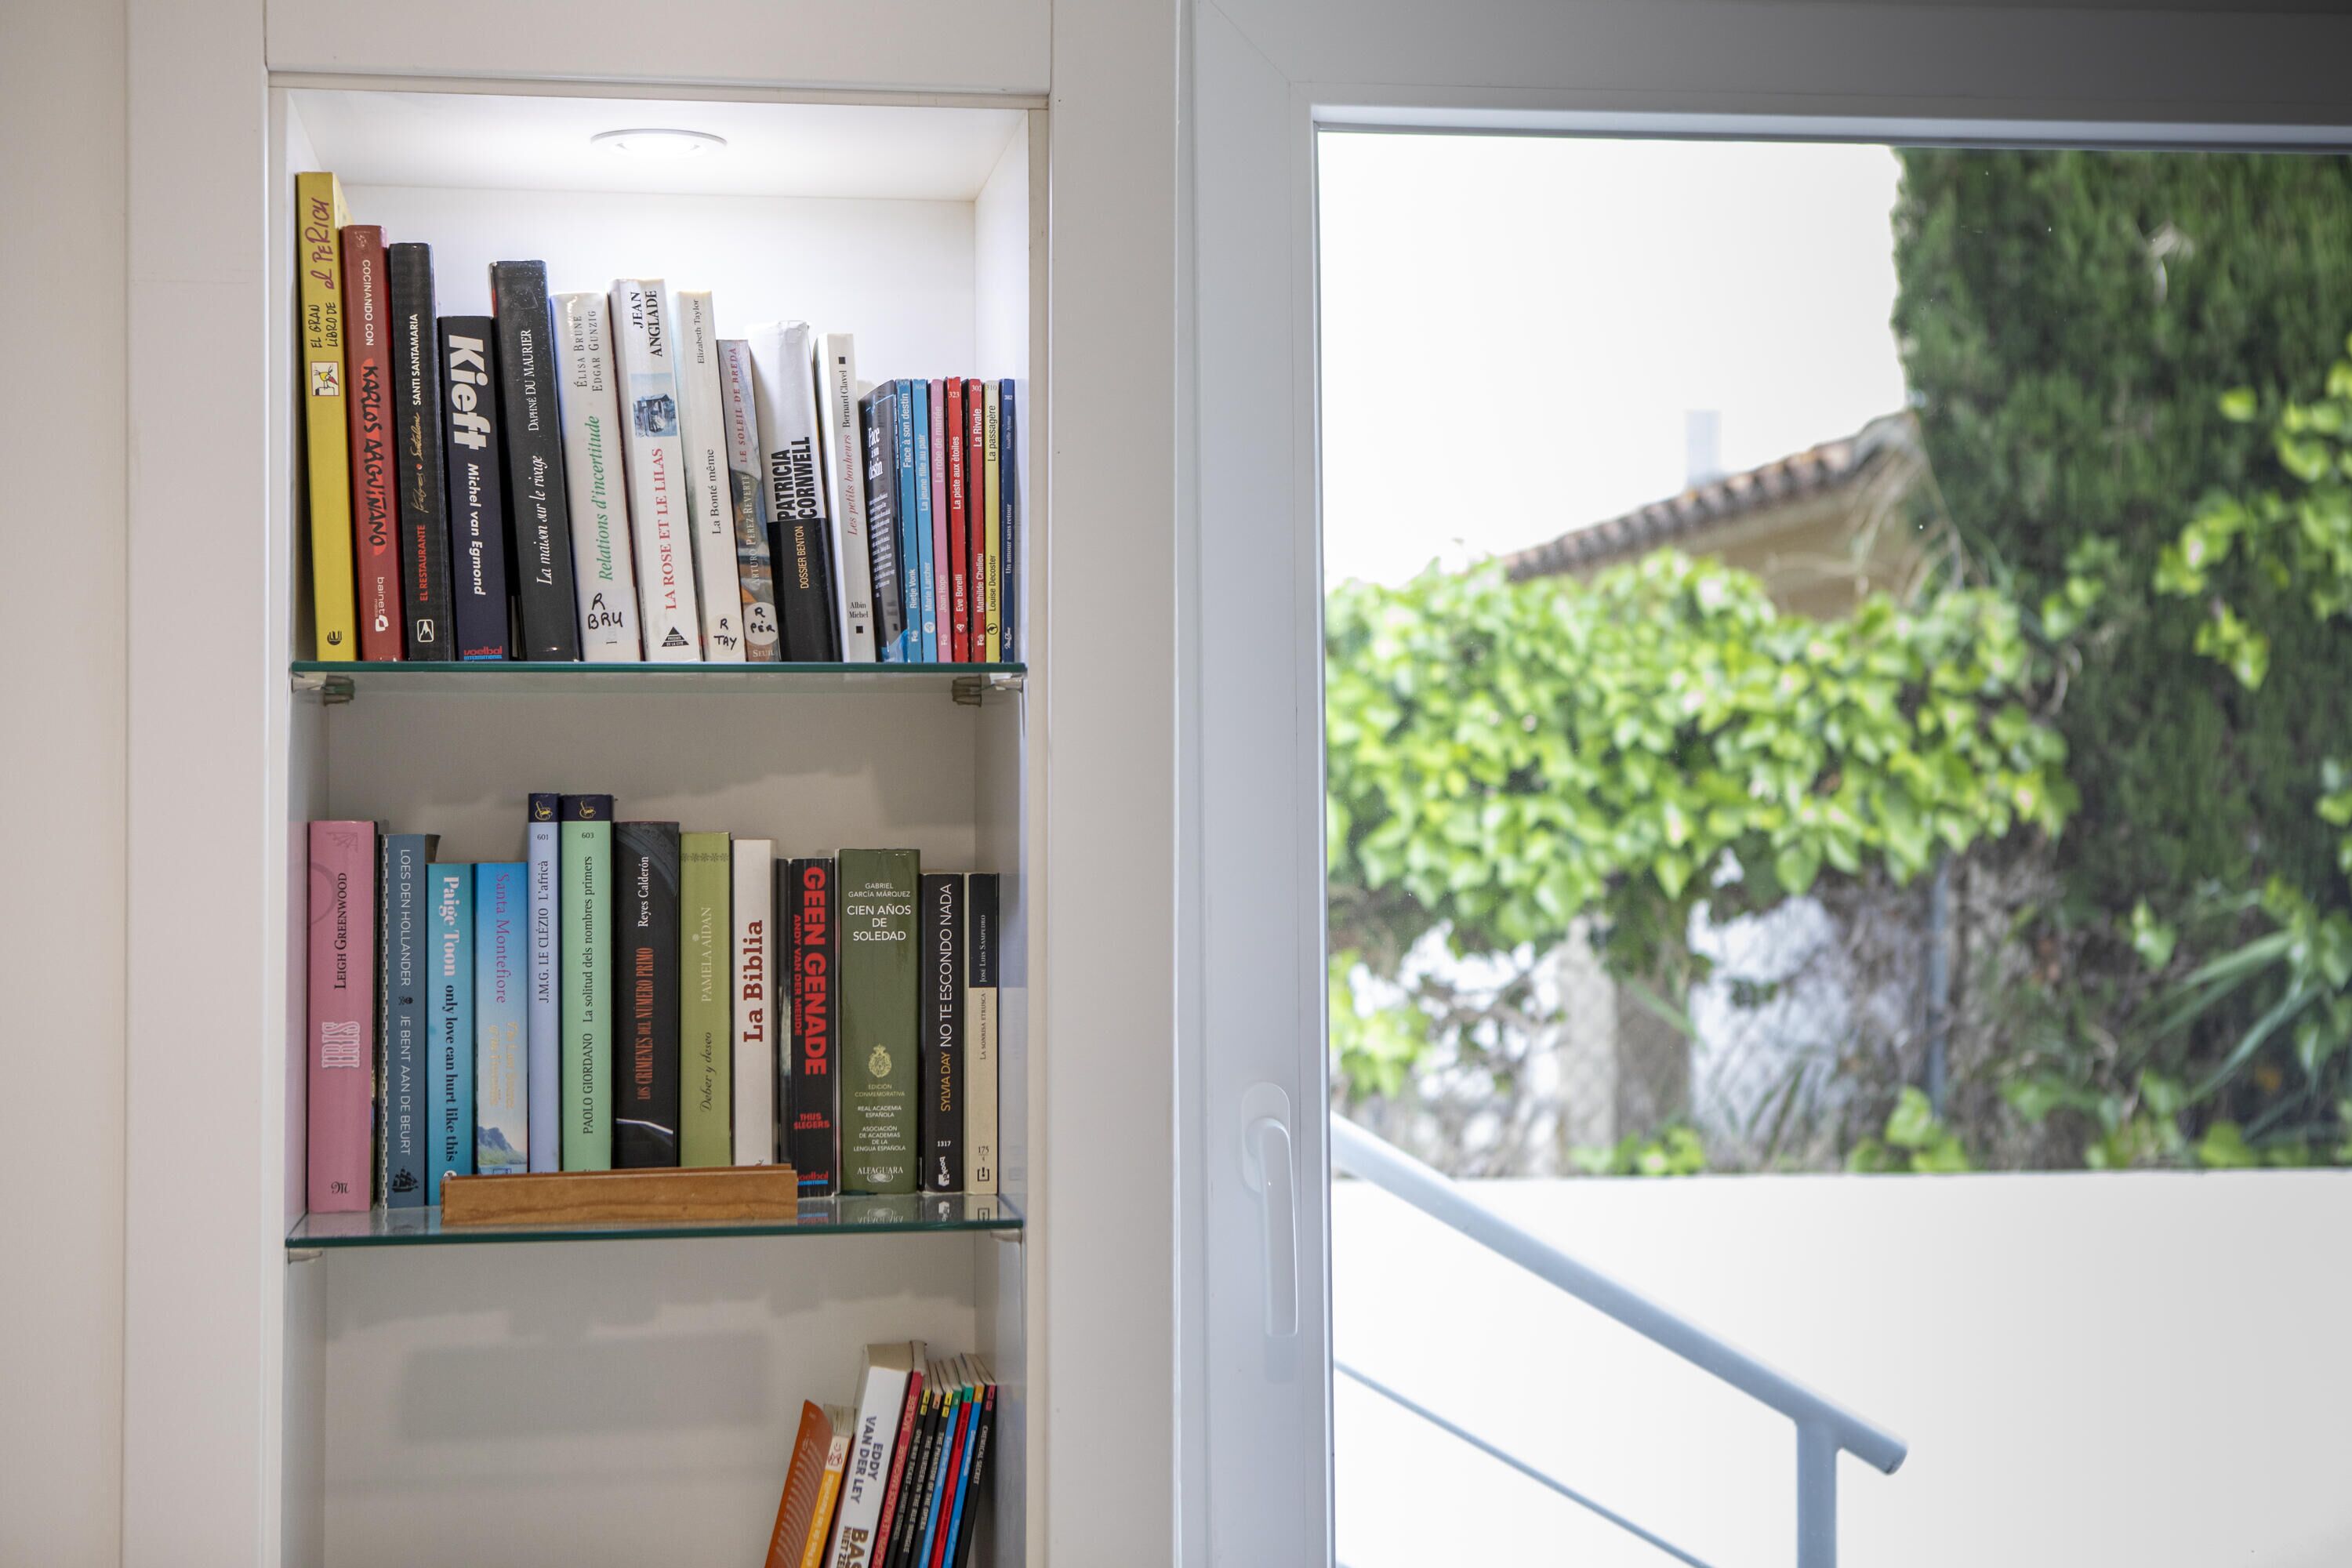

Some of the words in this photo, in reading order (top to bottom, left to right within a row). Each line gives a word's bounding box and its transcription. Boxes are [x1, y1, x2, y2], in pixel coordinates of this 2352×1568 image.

[362, 260, 373, 320] COCINANDO
[308, 304, 321, 333] GRAN
[630, 292, 644, 329] JEAN
[645, 290, 662, 358] ANGLADE
[693, 299, 702, 325] Taylor
[311, 337, 322, 349] EL
[365, 323, 374, 346] CON
[409, 314, 419, 378] SANTAMARIA
[574, 315, 585, 352] BRUNE
[589, 310, 599, 351] GUNZIG
[696, 327, 705, 364] Elizabeth
[574, 357, 587, 388] ÉLISA
[592, 357, 603, 392] EDGAR
[839, 370, 848, 394] Clavel
[412, 380, 422, 405] SANTI
[448, 335, 491, 450] Kieft
[839, 395, 851, 428] Bernard
[973, 408, 982, 434] Rivale
[987, 405, 997, 448] passagère
[903, 445, 912, 468] Face
[951, 436, 960, 462] étoiles
[973, 435, 982, 447] La
[988, 451, 996, 461] La
[528, 455, 548, 488] rivage
[584, 416, 608, 510] d'incertitude
[652, 448, 666, 491] LILAS
[707, 449, 717, 482] même
[841, 434, 854, 482] bonheurs
[468, 463, 481, 507] Michel
[771, 449, 797, 521] PATRICIA
[791, 436, 818, 519] CORNWELL
[953, 476, 962, 498] piste
[529, 490, 545, 502] le
[656, 495, 668, 515] LE
[710, 485, 720, 517] Bonté
[843, 484, 858, 516] petits
[953, 499, 961, 510] La
[470, 510, 479, 536] van
[536, 503, 547, 522] sur
[712, 520, 721, 535] La
[847, 520, 858, 535] Les
[534, 524, 550, 564] maison
[659, 521, 670, 540] ET
[796, 525, 807, 555] BENTON
[417, 524, 426, 587] RESTAURANTE
[596, 514, 613, 581] Relations
[469, 540, 486, 595] Egmond
[537, 568, 552, 585] La
[661, 543, 675, 586] ROSE
[798, 556, 809, 589] DOSSIER
[419, 589, 429, 601] EL
[665, 590, 677, 610] LA
[909, 590, 919, 608] Rietje
[714, 634, 738, 650] TAY
[401, 849, 411, 880] LOES
[582, 856, 595, 895] primers
[637, 856, 649, 898] Calderón
[401, 883, 411, 908] DEN
[438, 877, 460, 926] Paige
[495, 873, 510, 914] Santa
[803, 866, 826, 946] GEEN
[939, 884, 952, 925] NADA
[334, 872, 347, 950] GREENWOOD
[583, 898, 593, 944] nombres
[637, 901, 649, 927] Reyes
[847, 905, 874, 916] CIEN
[877, 903, 911, 915] AÑOS
[872, 917, 887, 927] DE
[701, 907, 711, 946] AIDAN
[853, 931, 906, 941] SOLEDAD
[401, 911, 411, 986] HOLLANDER
[444, 929, 460, 977] Toon
[495, 919, 511, 1004] Montefiore
[583, 947, 593, 967] dels
[742, 920, 763, 1000] Biblia
[939, 928, 953, 1000] ESCONDO
[334, 953, 347, 989] LEIGH
[702, 950, 711, 1002] PAMELA
[442, 985, 458, 1014] only
[583, 972, 593, 1007] solitud
[401, 1015, 411, 1026] JE
[583, 1009, 593, 1022] La
[743, 1008, 763, 1043] La
[804, 953, 827, 1076] GENADE
[939, 1004, 952, 1021] TE
[321, 1021, 360, 1068] IRIS
[445, 1017, 458, 1044] love
[939, 1024, 952, 1047] NO
[401, 1031, 411, 1062] BENT
[445, 1047, 456, 1071] can
[700, 1032, 712, 1063] deseo
[980, 1051, 986, 1060] LA
[583, 1033, 593, 1094] GIORDANO
[706, 1065, 717, 1074] y
[941, 1051, 951, 1074] DAY
[401, 1065, 411, 1092] AAN
[445, 1073, 458, 1104] hurt
[700, 1076, 712, 1112] Deber
[941, 1076, 951, 1112] SYLVIA
[401, 1095, 411, 1111] DE
[583, 1097, 593, 1134] PAOLO
[401, 1115, 411, 1156] BEURT
[445, 1108, 458, 1133] like
[445, 1135, 458, 1162] this
[857, 1167, 903, 1175] ALFAGUARA
[858, 1415, 877, 1448] VAN
[977, 1425, 988, 1458] CHEMICAL
[855, 1448, 870, 1478] DER
[867, 1443, 884, 1481] EDDY
[917, 1450, 930, 1483] MURDERS
[930, 1446, 941, 1481] PHANTOM
[973, 1460, 982, 1485] SECRET
[851, 1478, 864, 1504] LEY
[916, 1483, 923, 1492] IN
[927, 1481, 934, 1492] OF
[920, 1507, 929, 1530] OPERA
